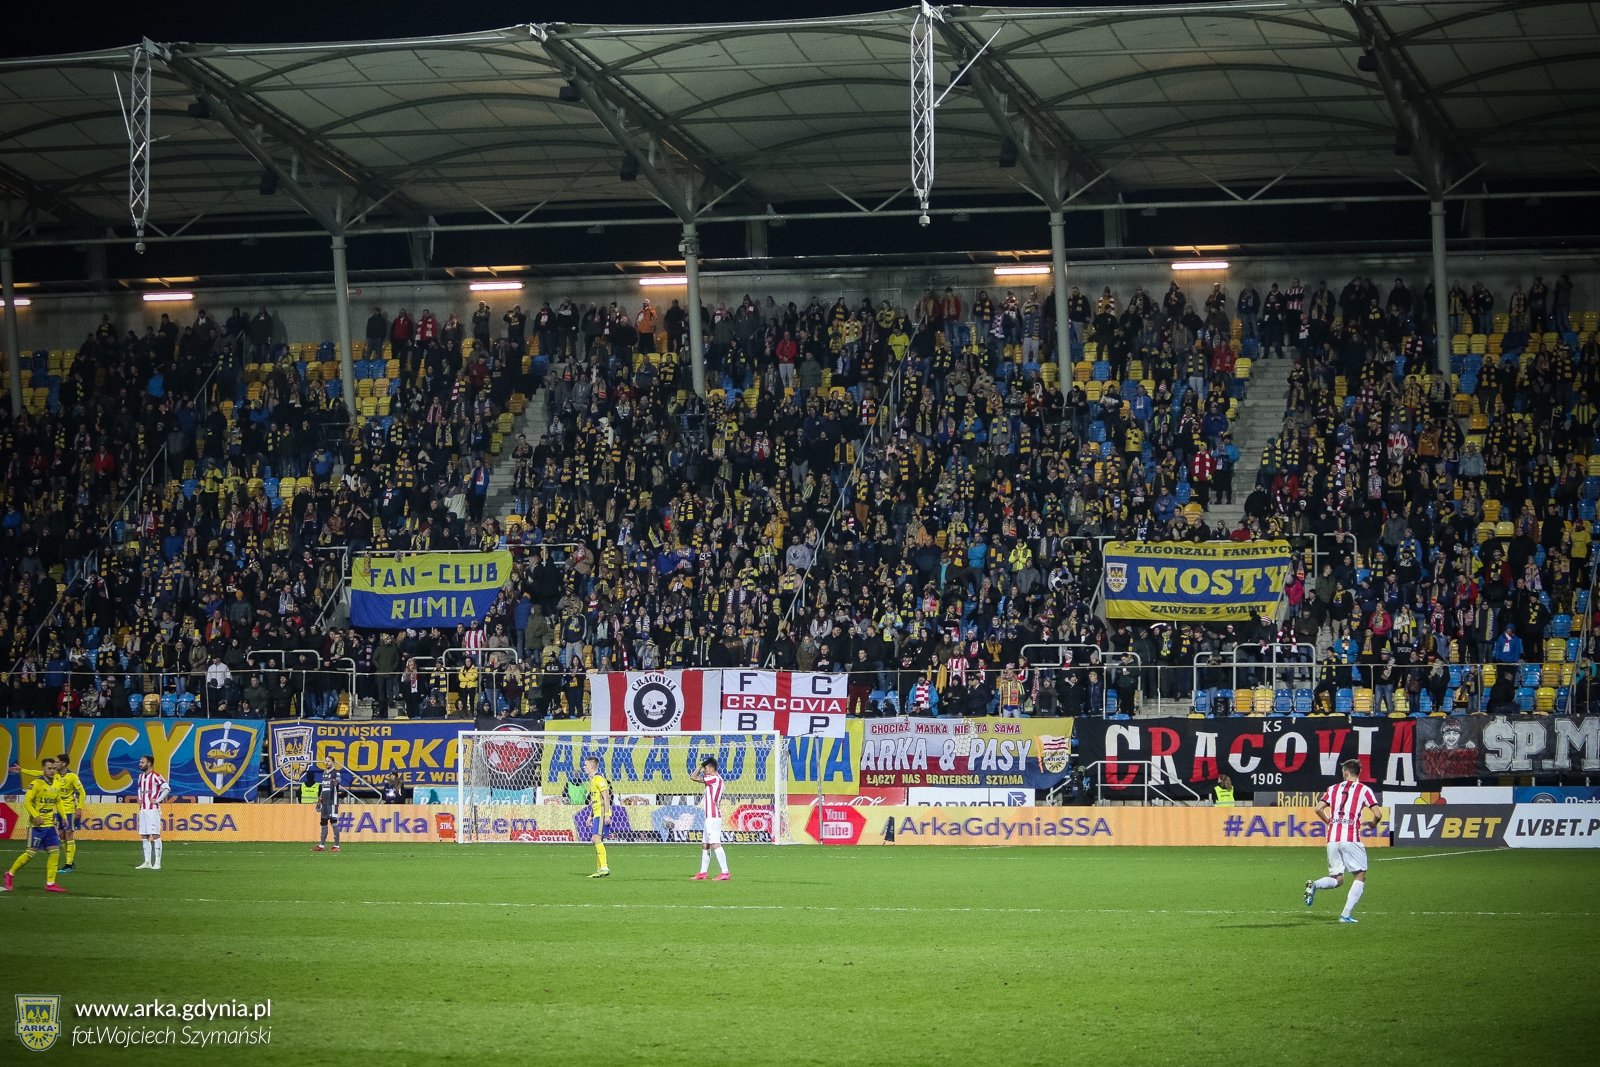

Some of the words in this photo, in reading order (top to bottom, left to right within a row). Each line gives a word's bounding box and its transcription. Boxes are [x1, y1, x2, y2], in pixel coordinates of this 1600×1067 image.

[1134, 545, 1217, 557] ZAGORZALI
[370, 562, 498, 588] FAN-CLUB
[1137, 565, 1289, 596] MOSTY
[391, 596, 476, 620] RUMIA
[1151, 605, 1207, 615] ZAWSZE
[1211, 606, 1221, 615] Z
[1226, 604, 1267, 615] WAMI
[631, 674, 677, 692] CRACOVIA
[739, 672, 758, 691] F
[811, 675, 832, 695] C
[727, 697, 842, 713] CRACOVIA
[316, 724, 392, 737] GDYŃSKA
[737, 712, 758, 731] B
[808, 715, 830, 734] P
[915, 723, 949, 735] MATKA
[953, 724, 970, 735] NIE
[976, 723, 988, 733] TA
[994, 723, 1022, 734] SAMA
[1262, 720, 1282, 733] KS
[547, 734, 673, 783] ARKA
[685, 732, 854, 783] GDYNIA
[860, 737, 928, 772] ARKA
[939, 738, 956, 771] &
[967, 738, 1032, 772] PASY
[1105, 719, 1418, 790] CRACOVIA
[351, 772, 412, 785] ZAWSE
[415, 771, 426, 782] Z
[429, 771, 470, 783] WAI
[866, 774, 896, 787] ŁĄCZY
[902, 774, 921, 785] NAS
[926, 774, 981, 786] BRATERSKA
[986, 774, 1024, 786] SZTAMA
[1250, 773, 1283, 785] 1906
[338, 812, 428, 834] #Arka
[825, 808, 847, 820] You
[897, 816, 1113, 840] ArkaGdyniaSSA
[1223, 814, 1326, 838] #Arka
[1399, 813, 1502, 839] LVBET
